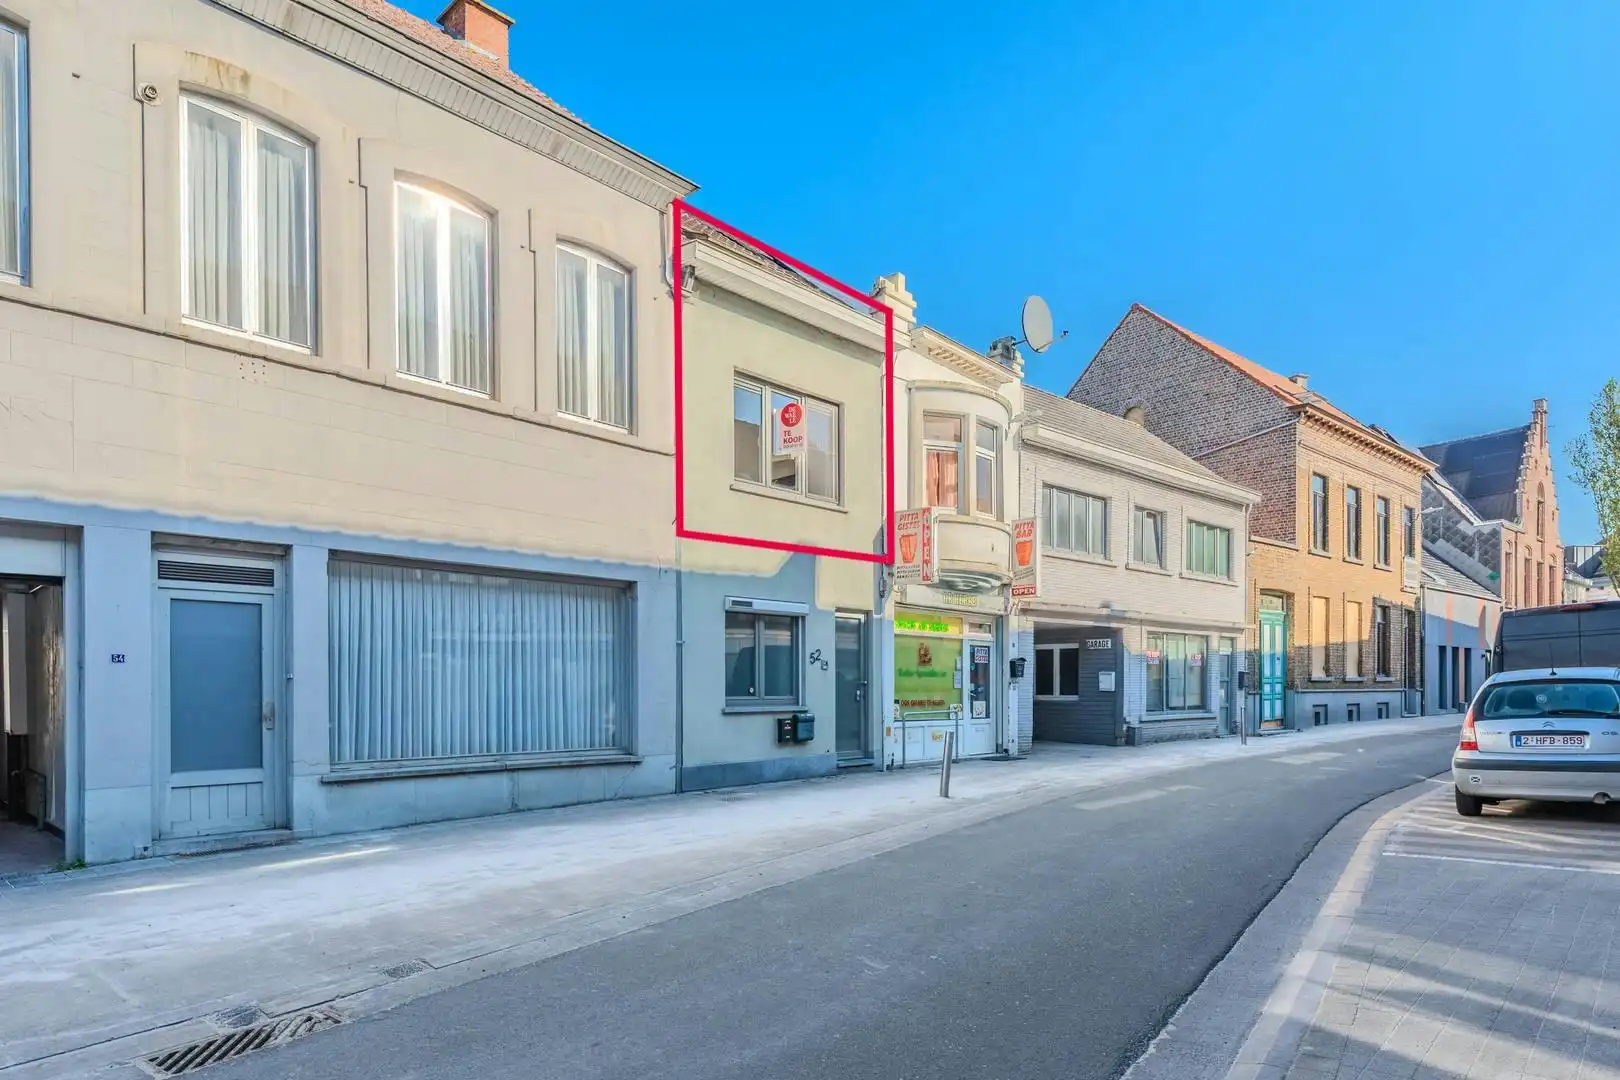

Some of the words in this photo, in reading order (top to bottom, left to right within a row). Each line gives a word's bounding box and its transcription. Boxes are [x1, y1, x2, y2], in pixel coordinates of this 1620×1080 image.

[783, 436, 803, 444] KOOP
[899, 512, 919, 521] PITTA
[1014, 521, 1035, 531] PITTA
[1015, 530, 1033, 538] BAR
[1087, 640, 1110, 649] GARAGE
[113, 654, 124, 662] 54
[809, 649, 821, 665] 52
